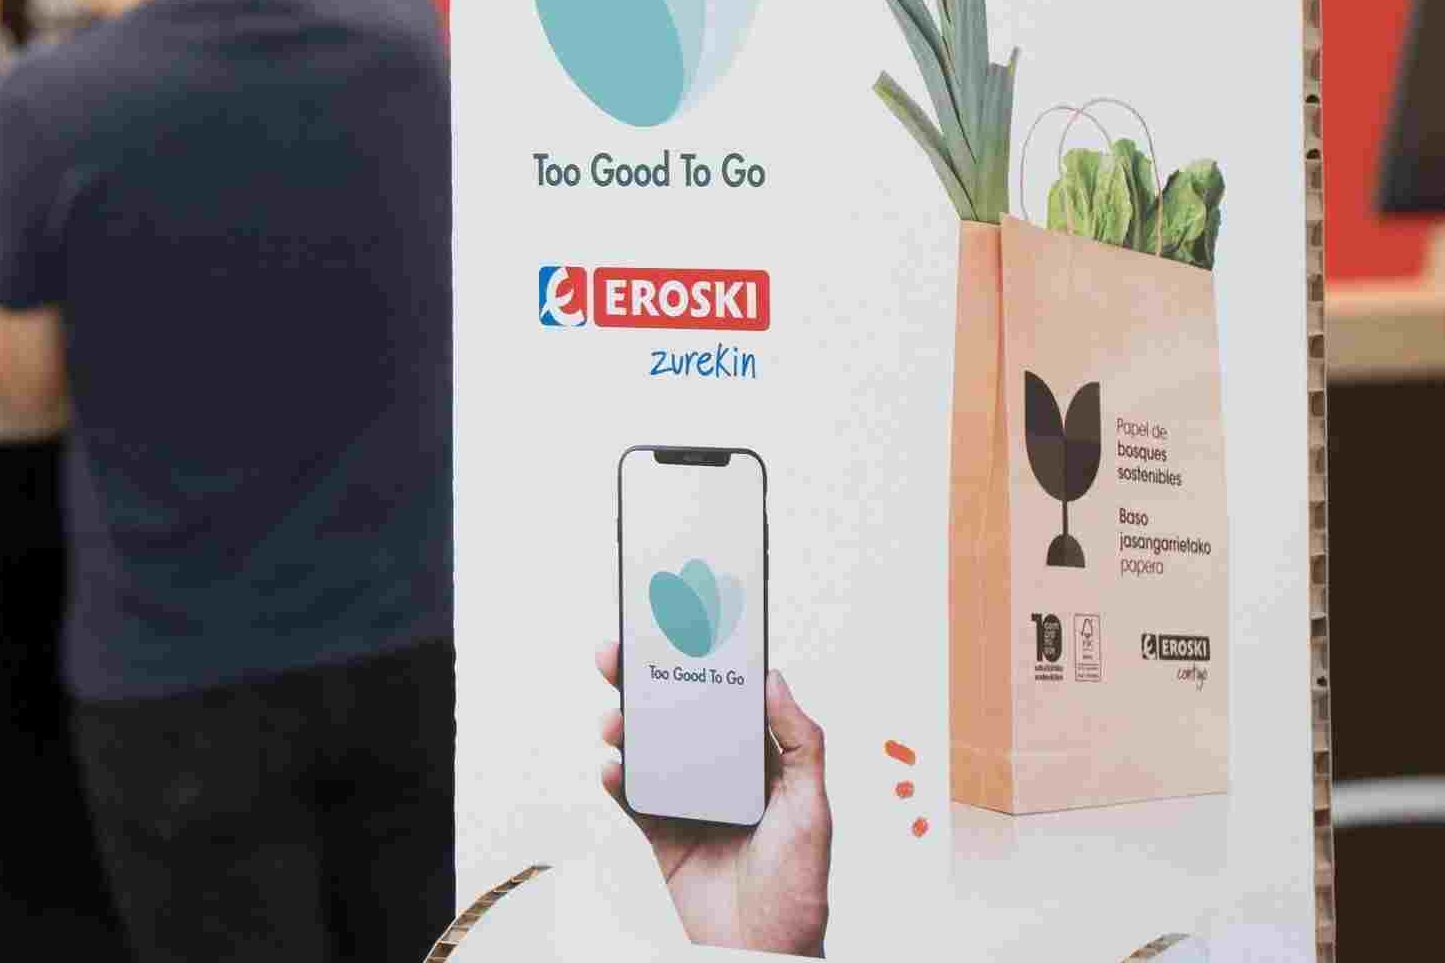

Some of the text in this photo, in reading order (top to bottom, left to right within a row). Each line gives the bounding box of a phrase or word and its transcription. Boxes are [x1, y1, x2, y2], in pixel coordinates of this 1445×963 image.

[533, 149, 766, 188] Too Good To Go
[606, 279, 757, 320] EROSKI
[649, 343, 757, 380] zurekin
[1116, 417, 1168, 440] Papel de
[1117, 440, 1168, 463] bosques
[1117, 465, 1183, 487] sostenibles
[1119, 507, 1149, 527] Baso
[1119, 532, 1212, 555] jasangarrietako
[1120, 557, 1164, 578] papera
[1161, 638, 1208, 657] EROSKI
[648, 664, 745, 686] Too Good To Go
